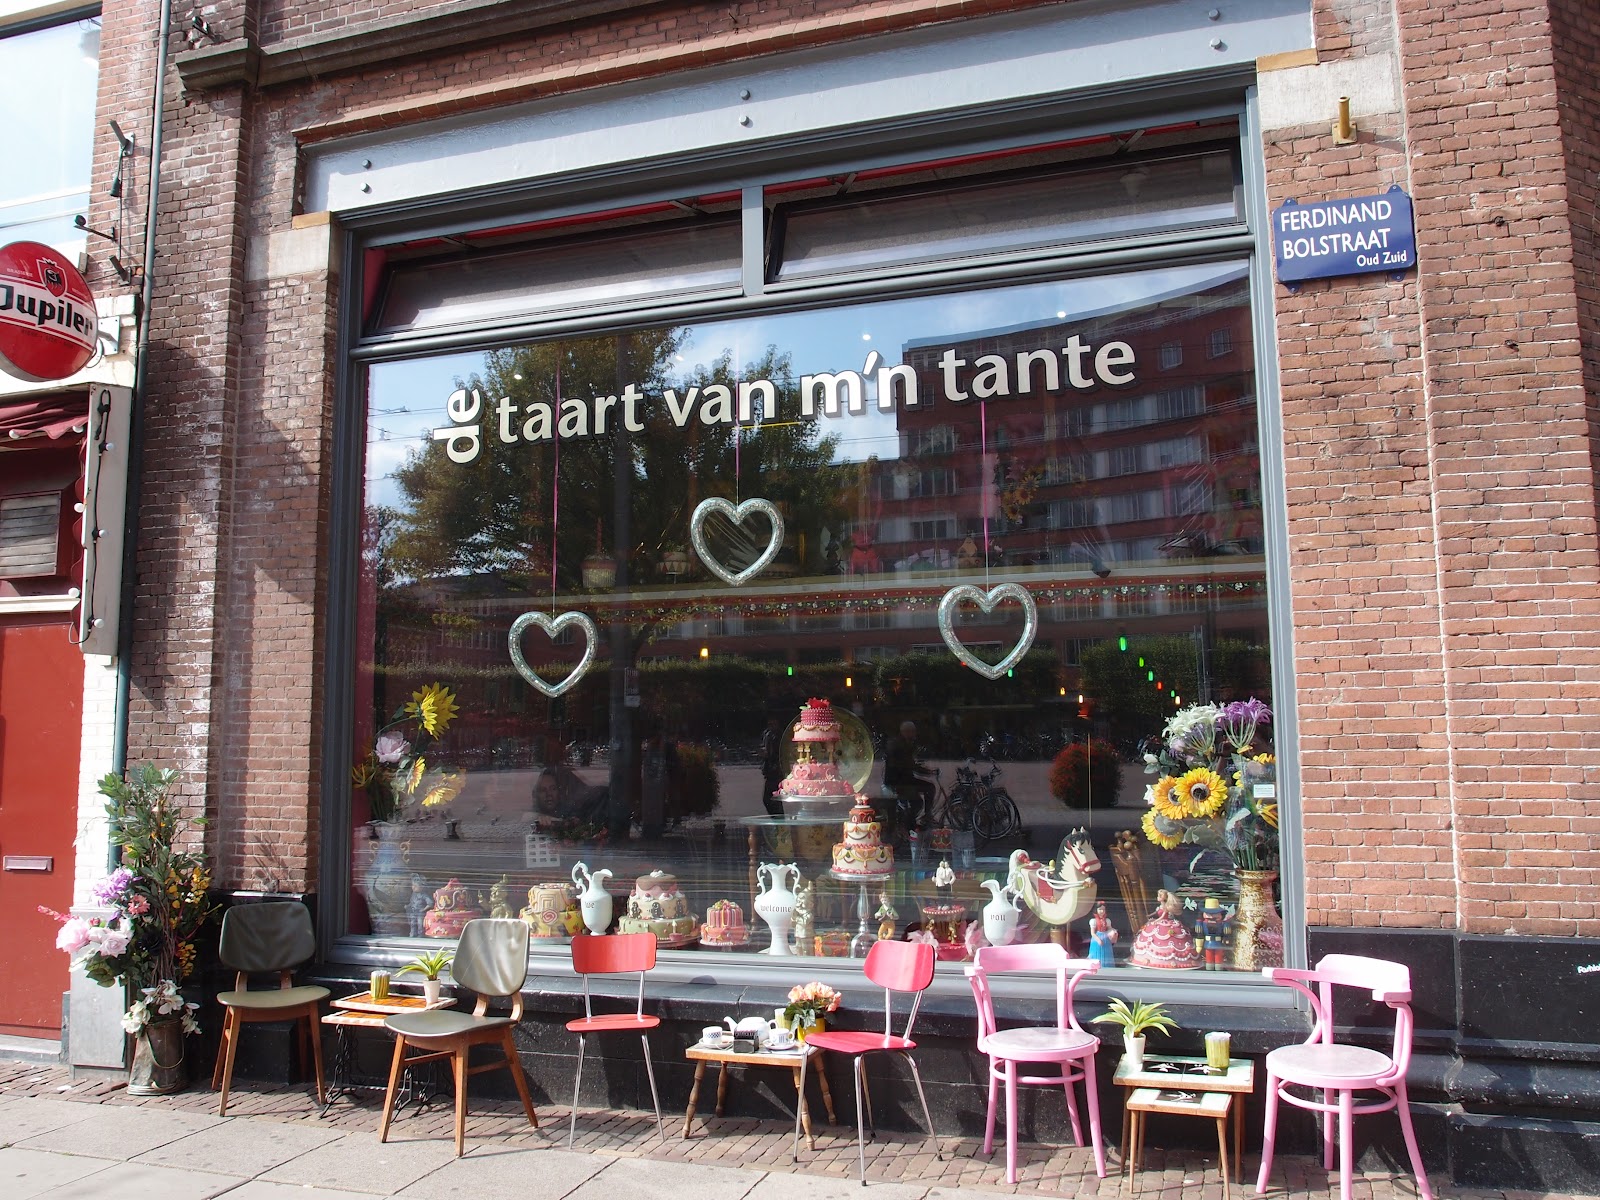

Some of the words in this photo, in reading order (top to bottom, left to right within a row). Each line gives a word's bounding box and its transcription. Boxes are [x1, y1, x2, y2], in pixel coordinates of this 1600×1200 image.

[1280, 200, 1392, 232] FERDINAND
[1282, 228, 1391, 260] BOLSTRAAT
[1356, 253, 1380, 267] Oud
[1382, 250, 1407, 264] Zuid
[0, 284, 93, 336] Jupiler
[432, 388, 481, 464] de
[495, 382, 646, 444] taart
[663, 378, 777, 427] van
[937, 334, 1136, 402] tante
[760, 904, 792, 913] welcome
